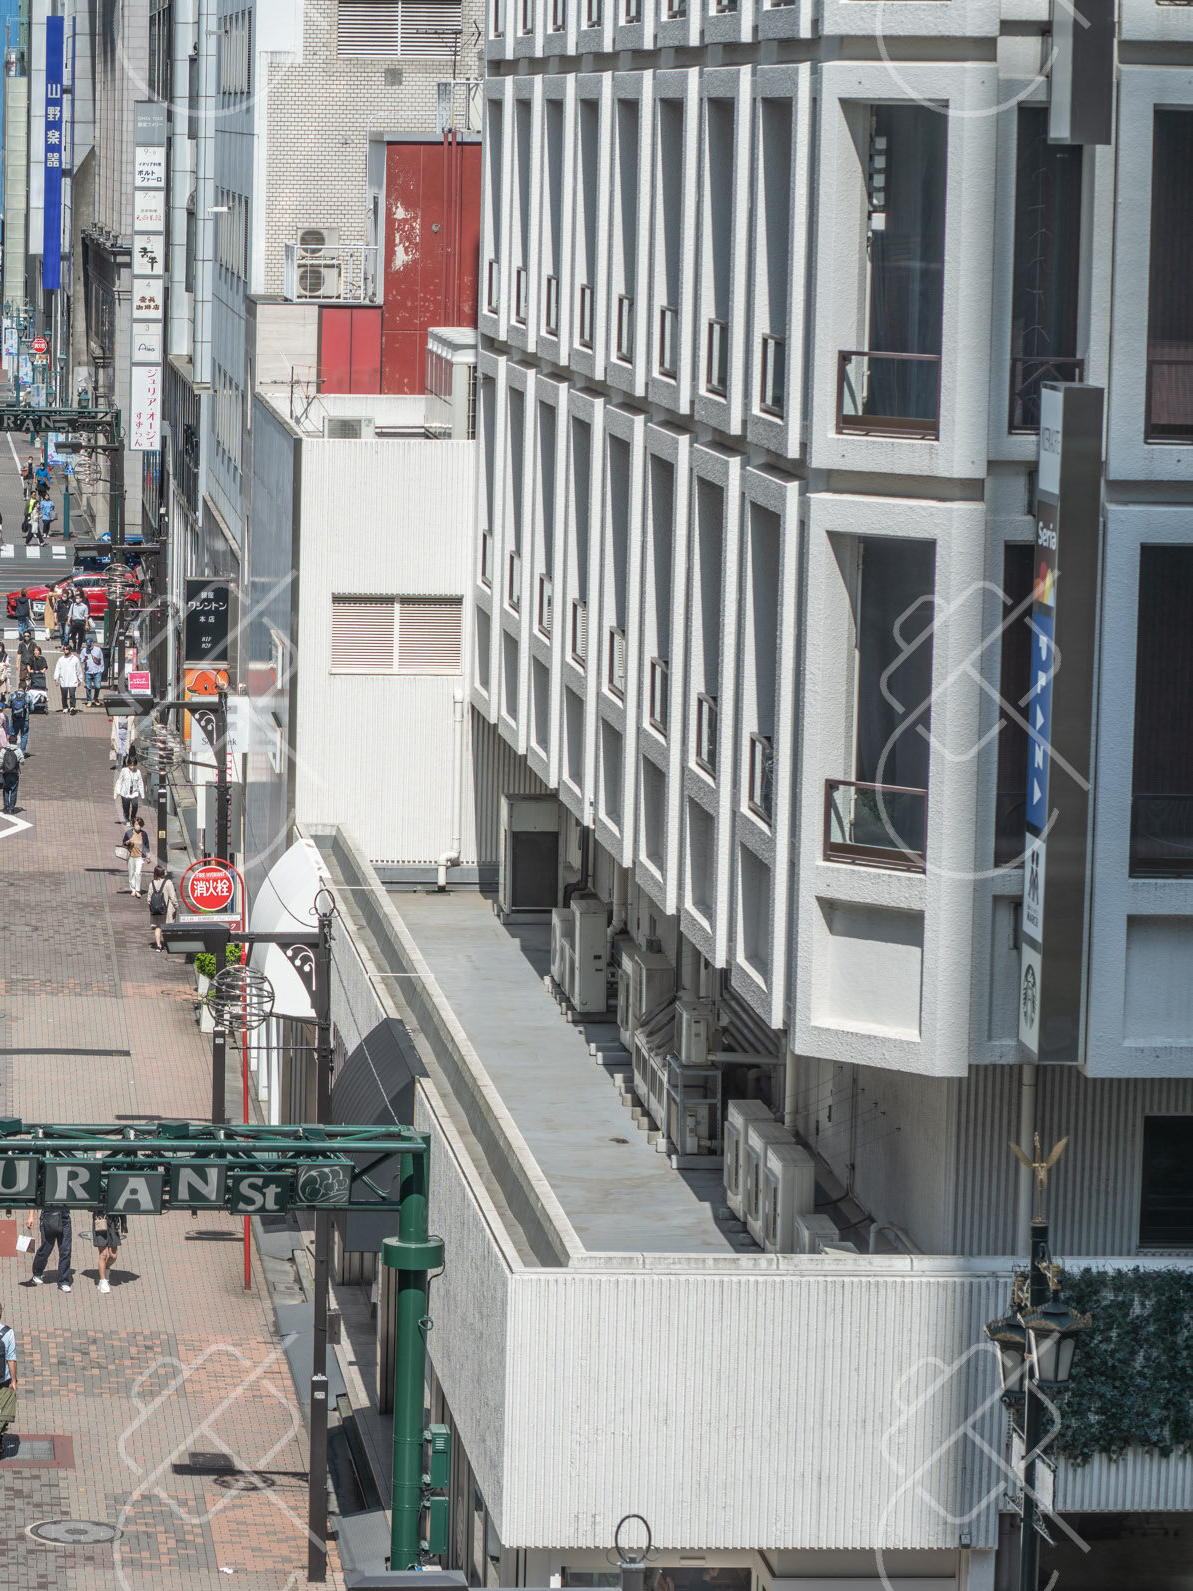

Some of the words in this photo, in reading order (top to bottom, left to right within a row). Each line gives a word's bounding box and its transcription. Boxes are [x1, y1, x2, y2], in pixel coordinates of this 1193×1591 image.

[46, 82, 61, 168] 山野楽器
[134, 411, 144, 447] すずらん
[1037, 521, 1057, 550] Seria
[188, 601, 227, 611] ワシントン
[193, 879, 230, 897] 消火栓
[238, 1176, 282, 1213] St
